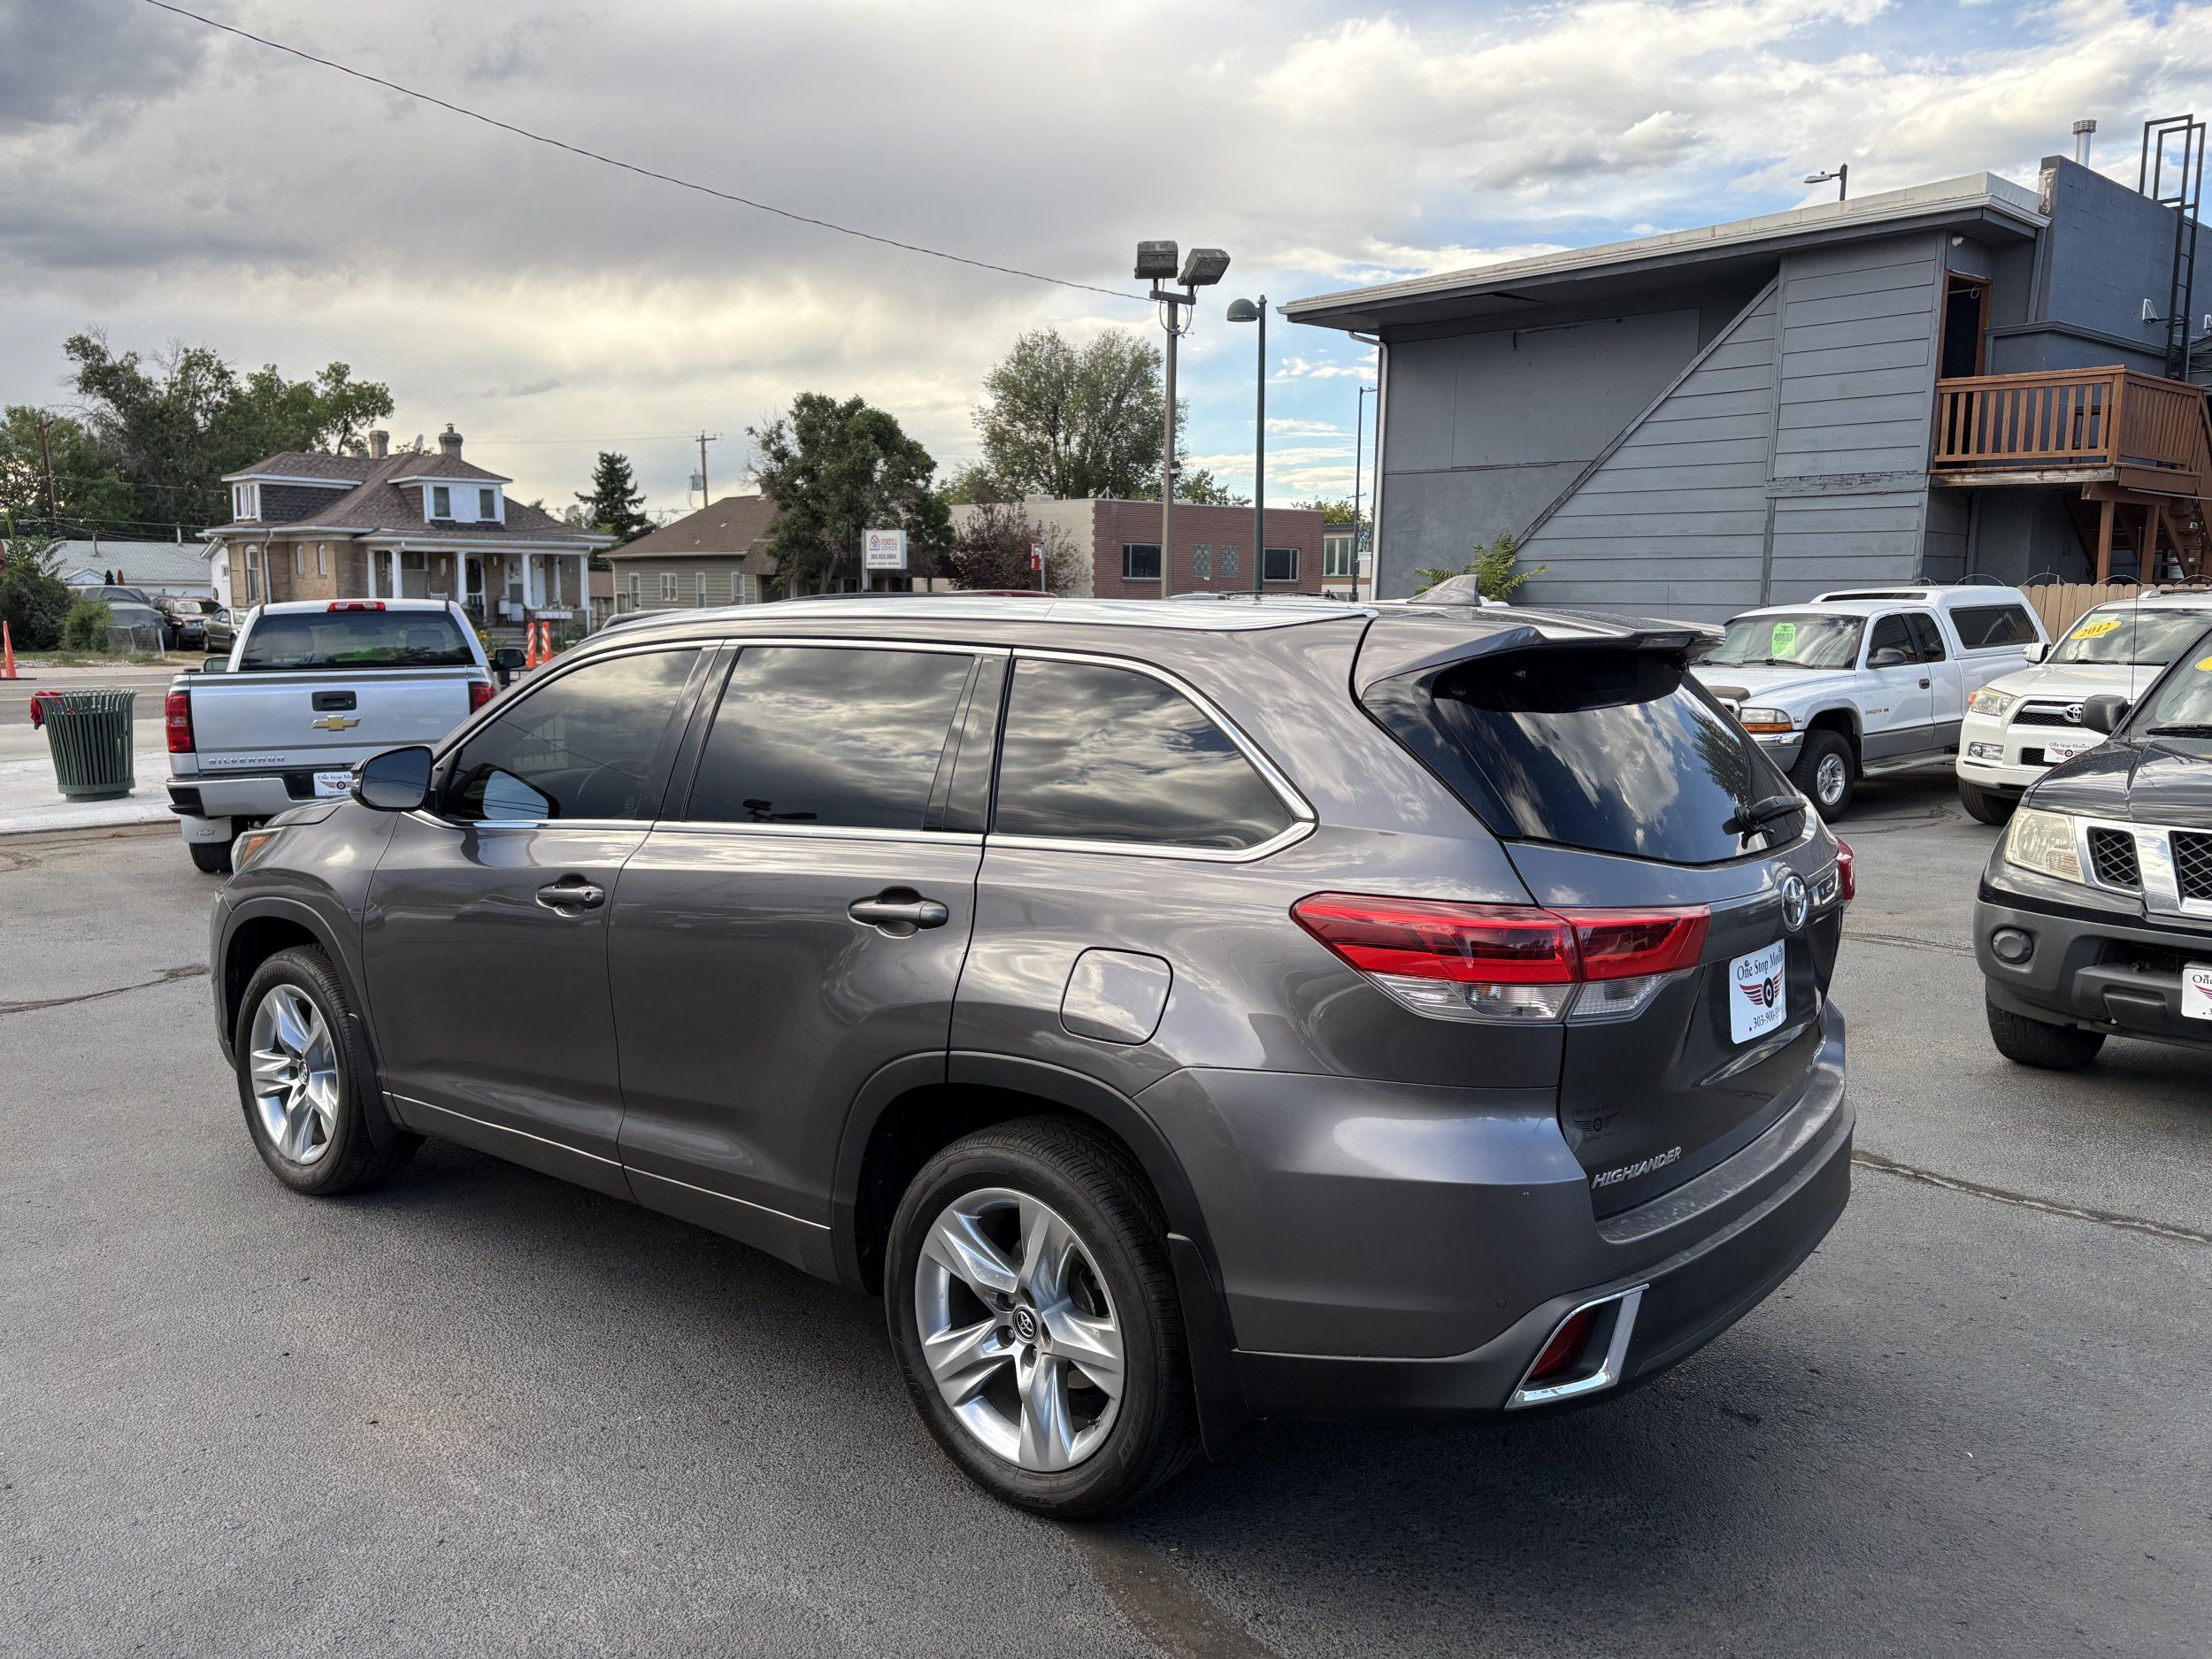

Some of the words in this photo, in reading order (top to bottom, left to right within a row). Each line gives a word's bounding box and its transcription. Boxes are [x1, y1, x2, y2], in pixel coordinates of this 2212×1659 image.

[2080, 623, 2111, 637] 2012
[1738, 965, 1753, 980] One
[1754, 959, 1768, 974] Stop
[1591, 1147, 1682, 1189] HIGHLANDER
